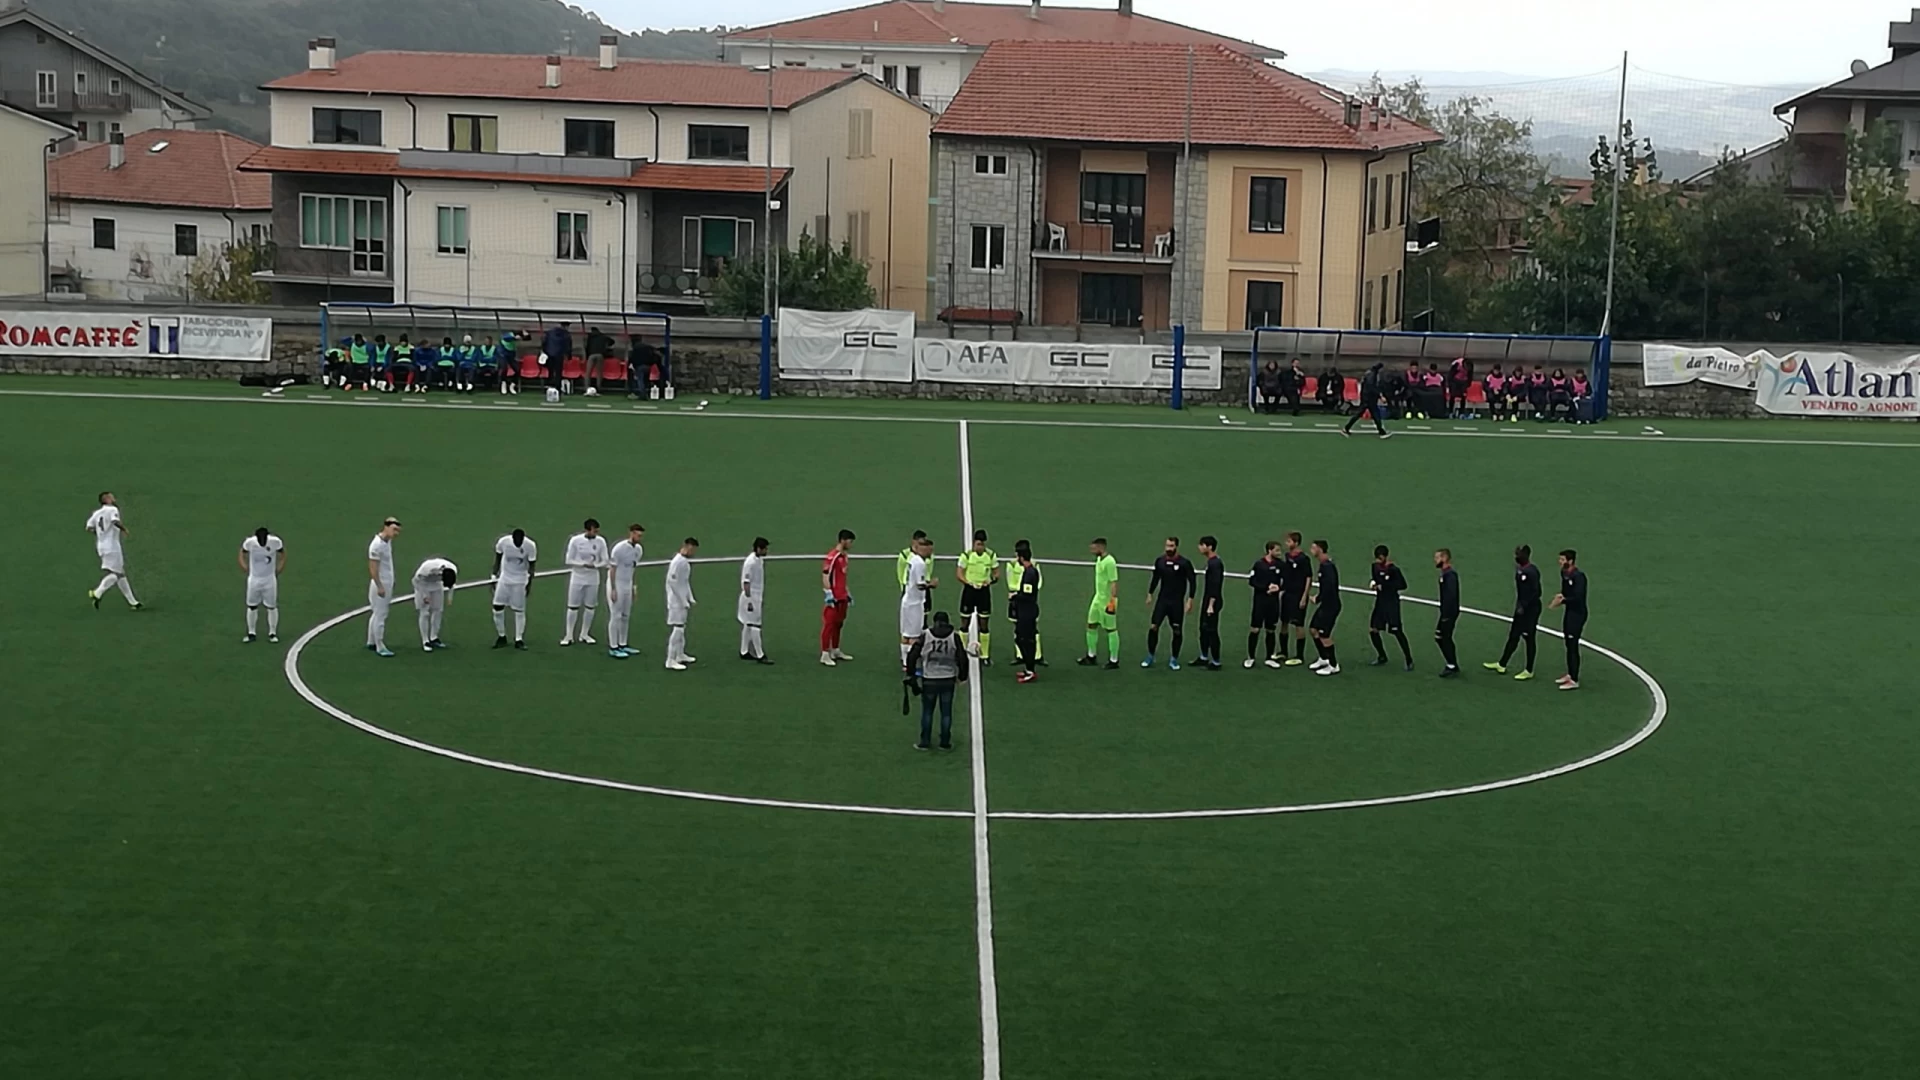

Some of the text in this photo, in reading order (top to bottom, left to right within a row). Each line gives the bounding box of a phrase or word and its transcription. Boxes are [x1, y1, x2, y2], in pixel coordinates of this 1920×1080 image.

[183, 317, 249, 327] TABACCHERIA
[183, 328, 242, 338] RICEVITORIA
[843, 331, 898, 348] GC
[958, 345, 1008, 364] AFA
[1050, 352, 1109, 367] GC
[1686, 356, 1701, 369] da
[1705, 355, 1740, 373] Pietro
[1785, 357, 1920, 398] Atlan
[1802, 400, 1858, 411] VENAFRO
[1867, 402, 1918, 412] AGNONE
[931, 639, 949, 654] 121
